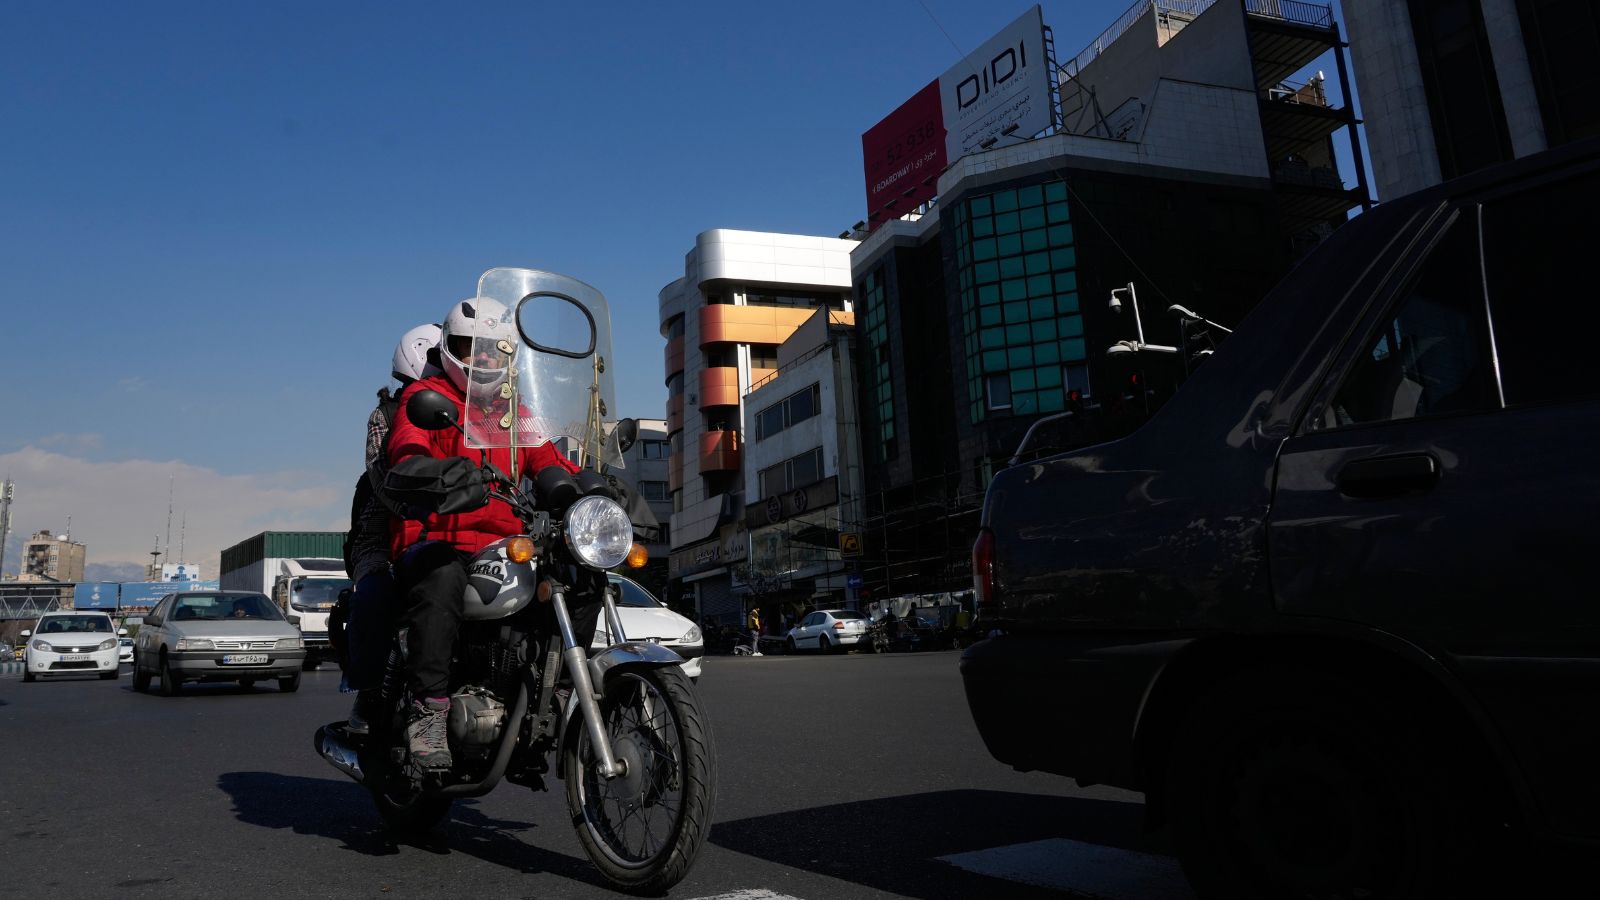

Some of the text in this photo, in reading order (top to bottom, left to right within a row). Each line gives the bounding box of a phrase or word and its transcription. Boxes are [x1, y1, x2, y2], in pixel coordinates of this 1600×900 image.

[957, 39, 1027, 112] DIDI
[906, 120, 935, 151] 938
[877, 163, 910, 192] BOARDWAY
